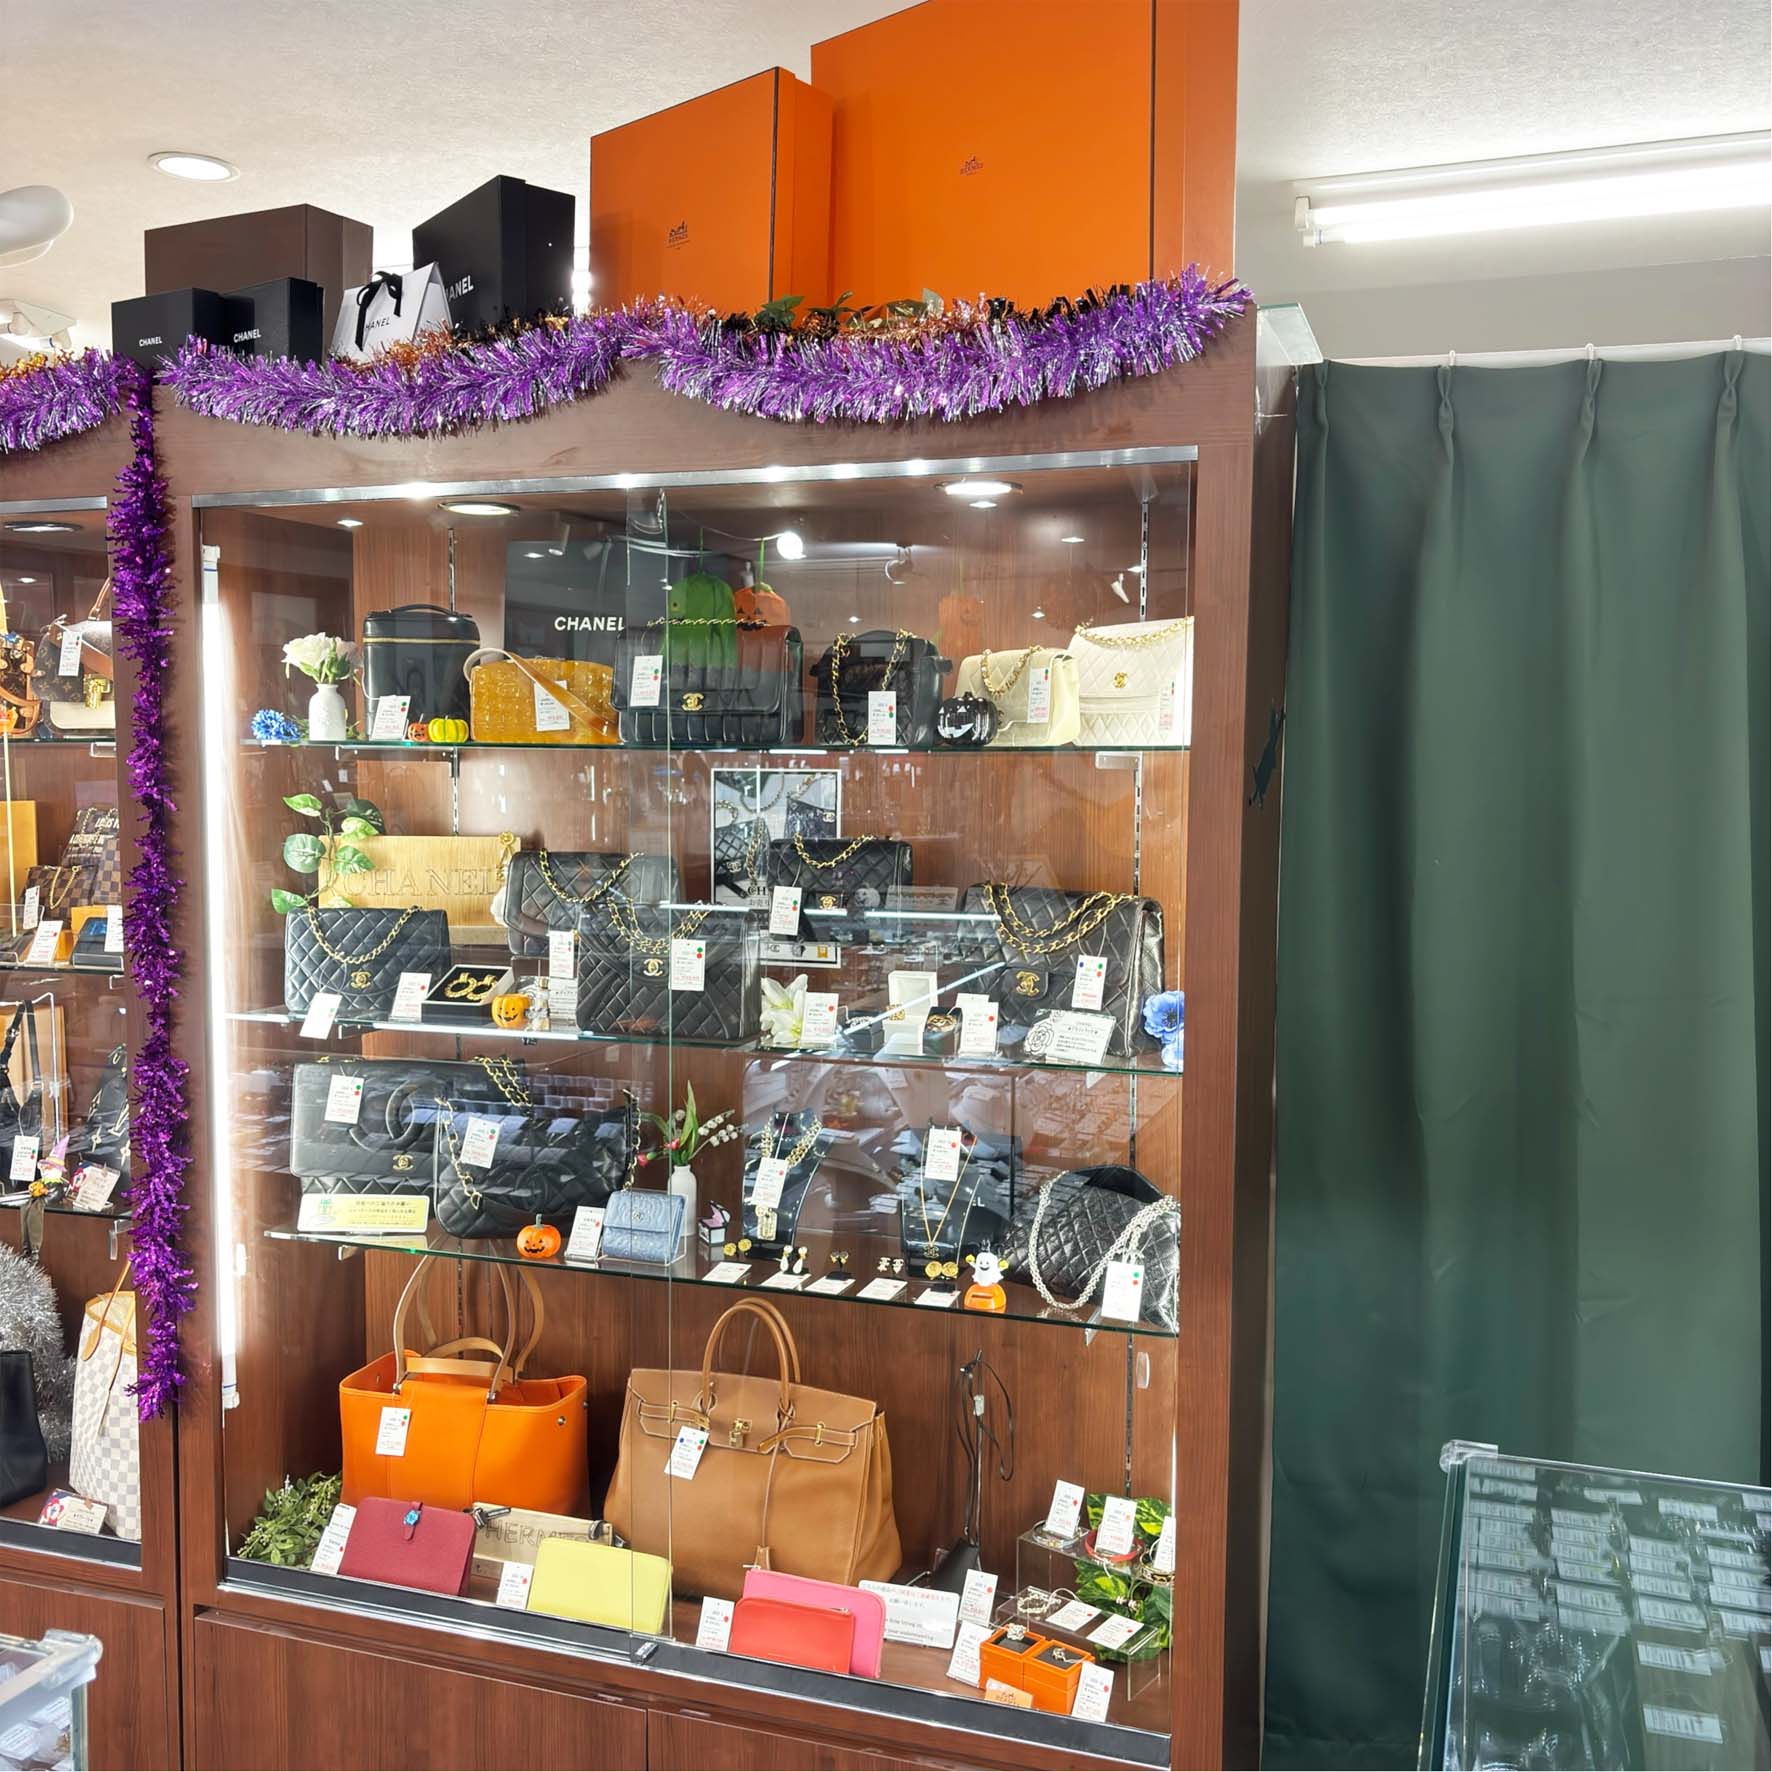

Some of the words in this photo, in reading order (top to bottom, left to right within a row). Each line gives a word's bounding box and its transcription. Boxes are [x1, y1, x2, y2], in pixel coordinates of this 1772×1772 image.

[445, 275, 474, 302] ANEL
[366, 316, 391, 329] HANEL
[138, 335, 163, 347] CHANEL
[233, 328, 262, 343] CHANEL
[553, 616, 625, 631] CHANEL
[343, 867, 499, 897] CHANEL
